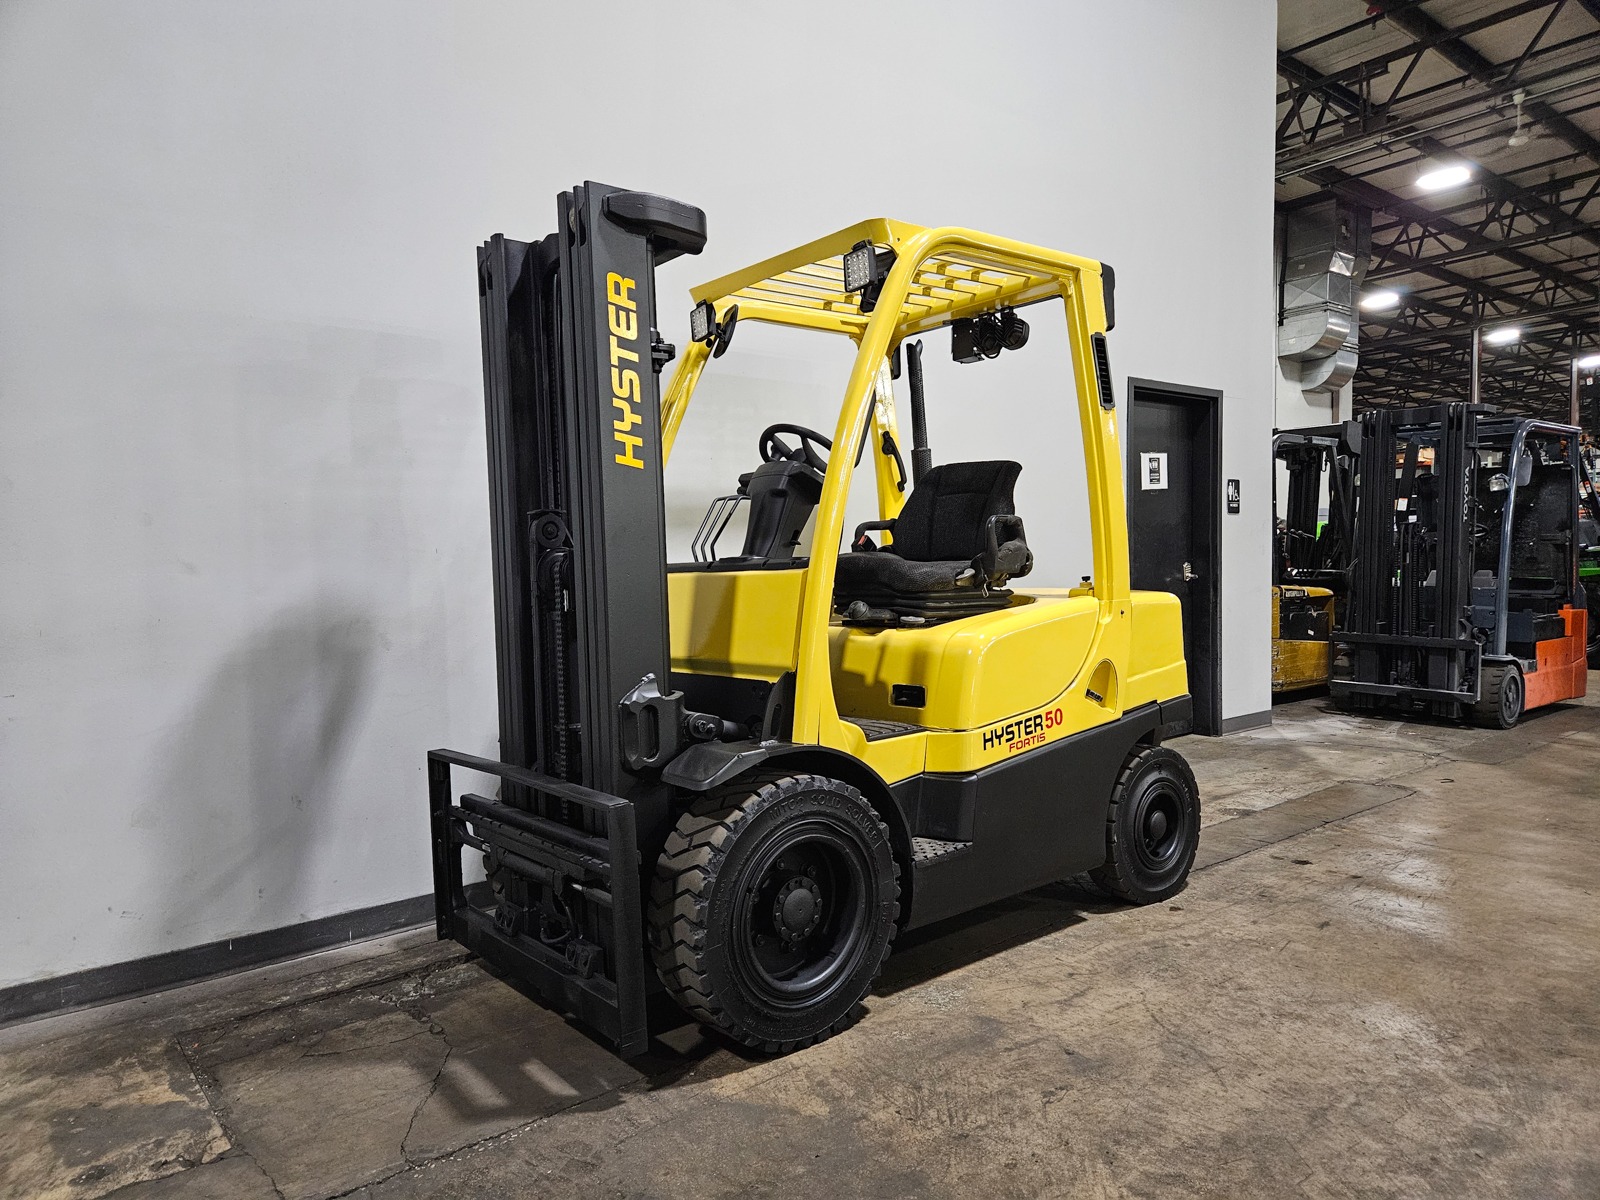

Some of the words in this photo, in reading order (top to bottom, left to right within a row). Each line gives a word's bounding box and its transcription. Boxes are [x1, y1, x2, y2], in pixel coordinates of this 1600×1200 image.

[606, 271, 645, 470] HYSTER
[983, 714, 1043, 751] HYSTER
[1045, 708, 1063, 729] 50
[1009, 732, 1046, 752] FORTIS
